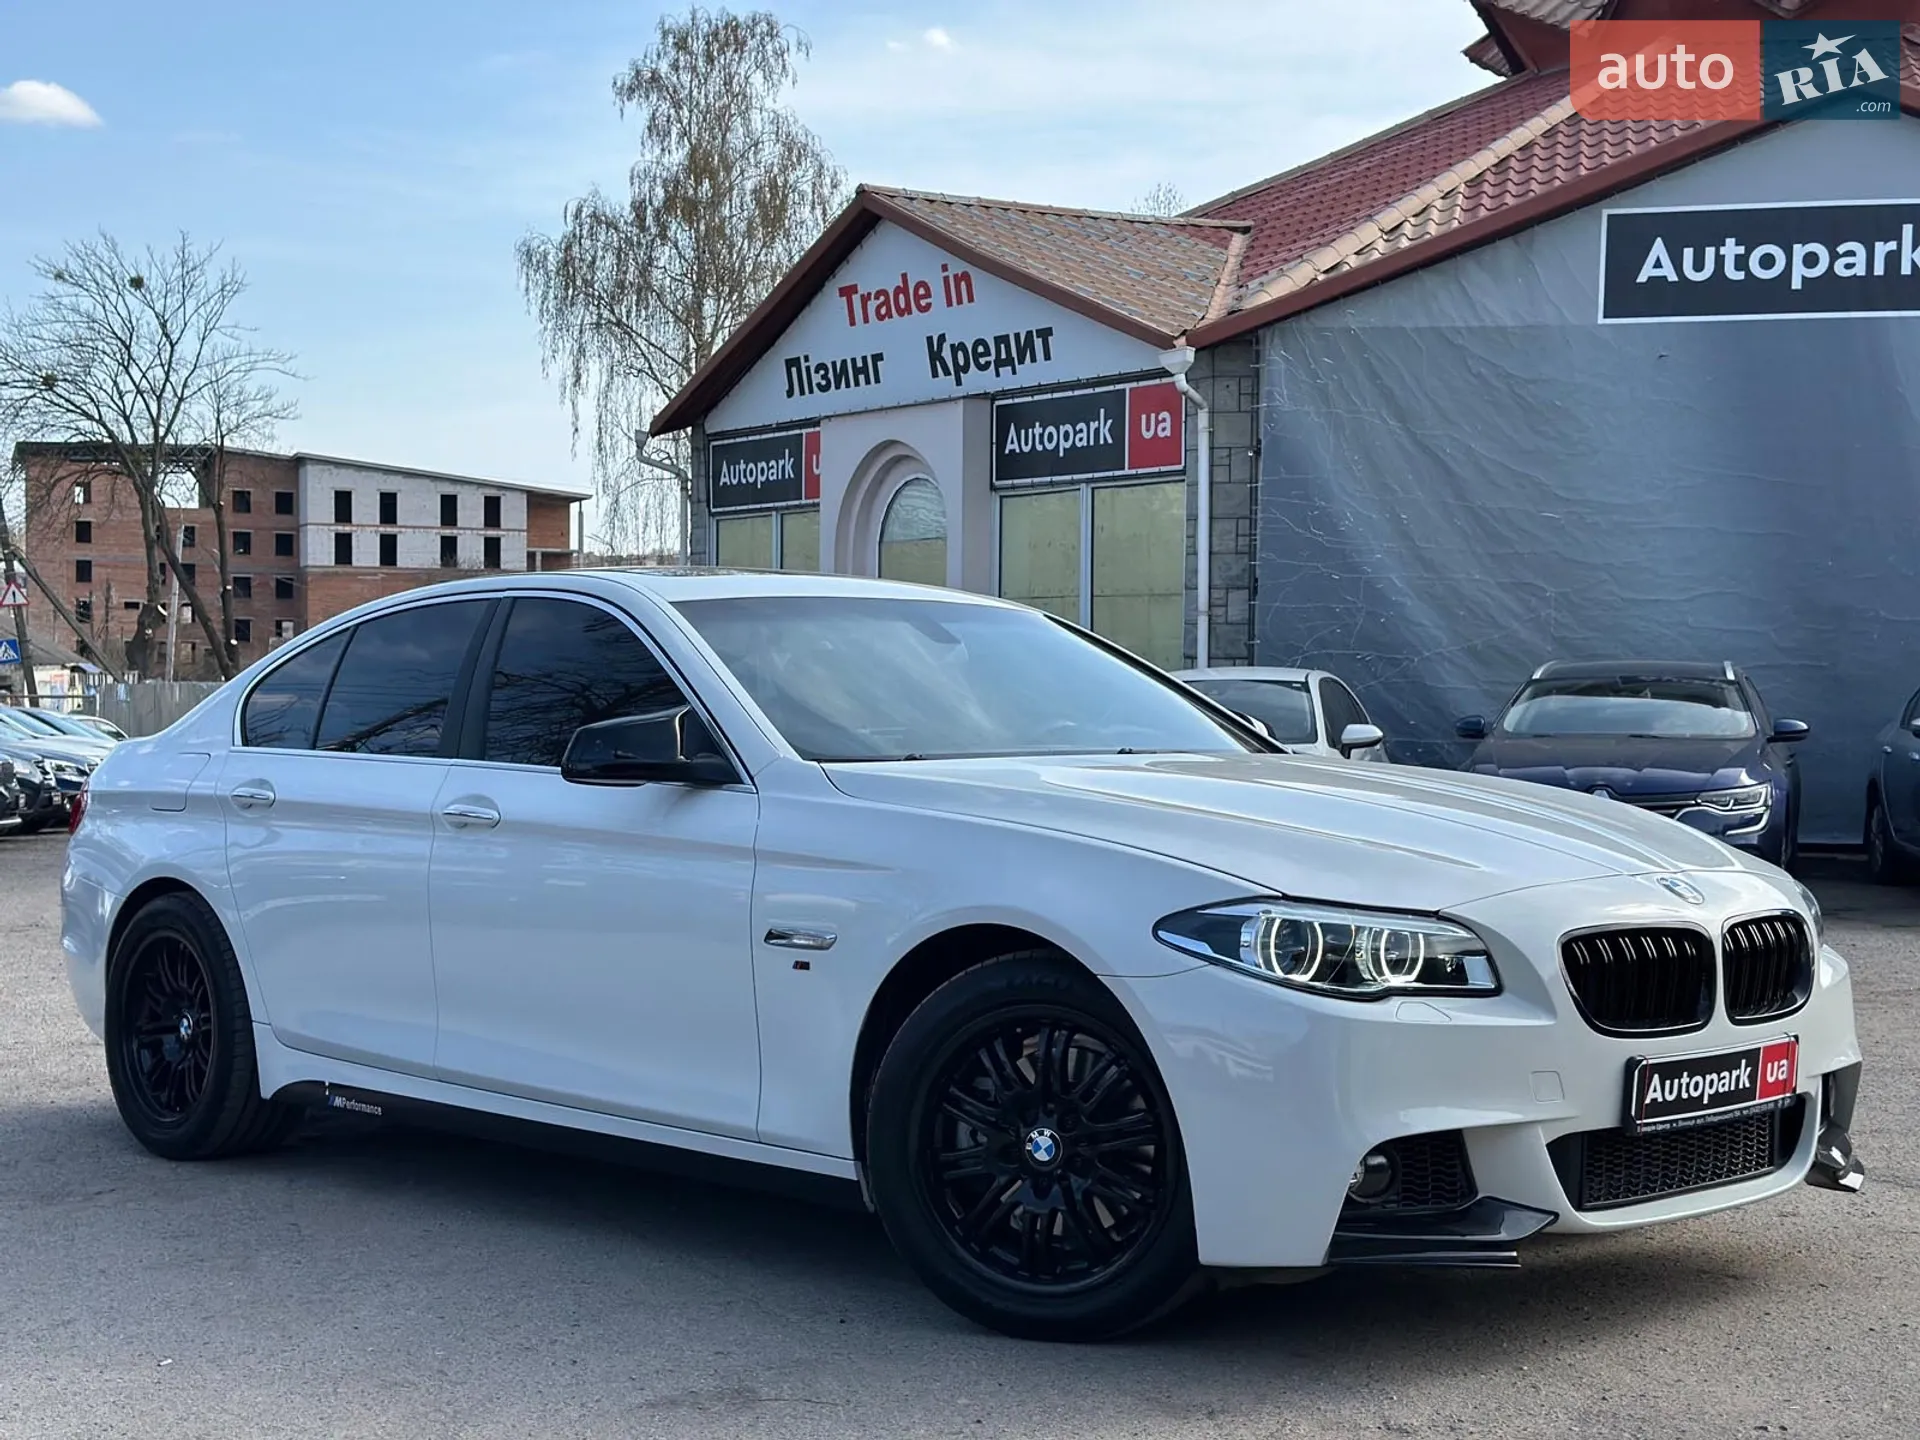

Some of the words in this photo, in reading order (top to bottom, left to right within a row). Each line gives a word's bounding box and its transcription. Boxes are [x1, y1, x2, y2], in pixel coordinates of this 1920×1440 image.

[1635, 223, 1920, 290] Autopark
[838, 272, 932, 327] Trade
[941, 264, 975, 308] in
[784, 352, 885, 399] Лізинг
[926, 326, 1054, 387] Кредит
[1004, 408, 1113, 457] Autopark
[1140, 411, 1171, 439] ua
[719, 448, 795, 489] Autopark
[812, 454, 820, 475] u
[1644, 1058, 1752, 1105] Autopark
[1765, 1058, 1789, 1083] ua
